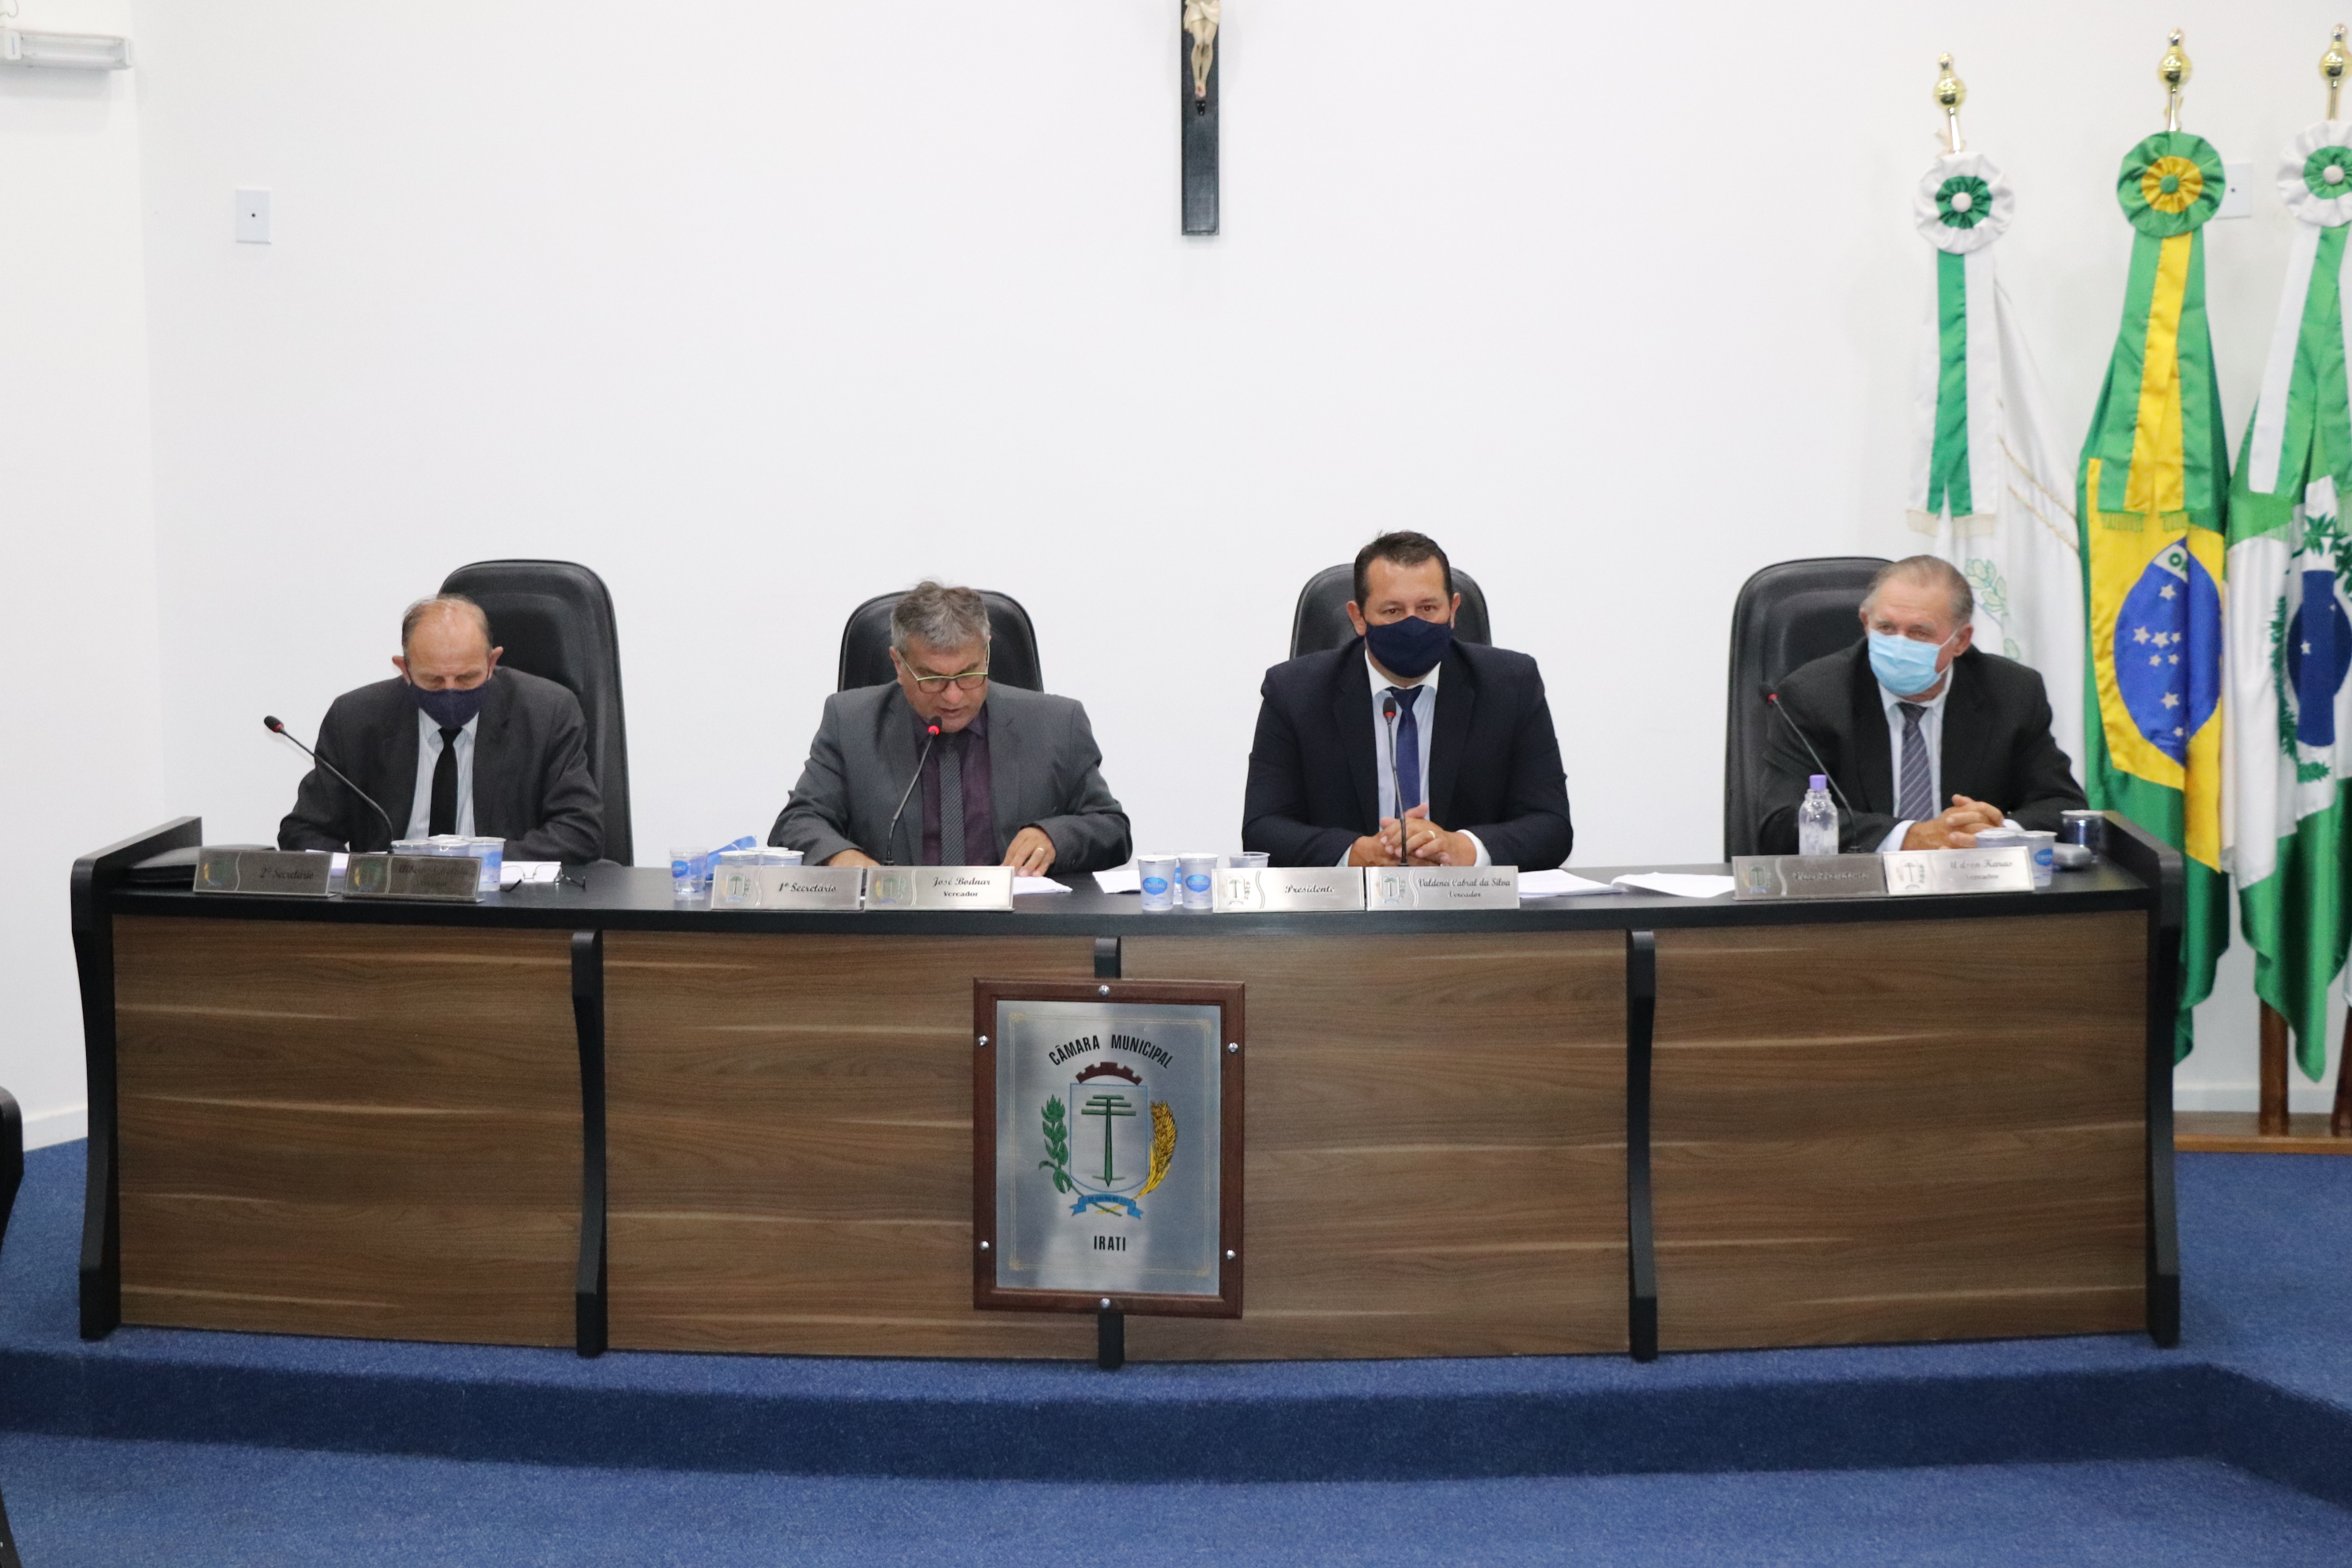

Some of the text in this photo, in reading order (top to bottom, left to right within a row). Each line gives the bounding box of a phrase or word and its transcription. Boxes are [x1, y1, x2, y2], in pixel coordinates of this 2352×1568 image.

[790, 882, 836, 892] Secretário
[933, 876, 991, 887] José Bodnar
[1418, 876, 1511, 887] Valdenei Cabral da Silva
[1284, 884, 1335, 894] Presidente
[1048, 1034, 1174, 1069] CÂMARA MUNICIPAL
[1094, 1235, 1126, 1251] IRATI
